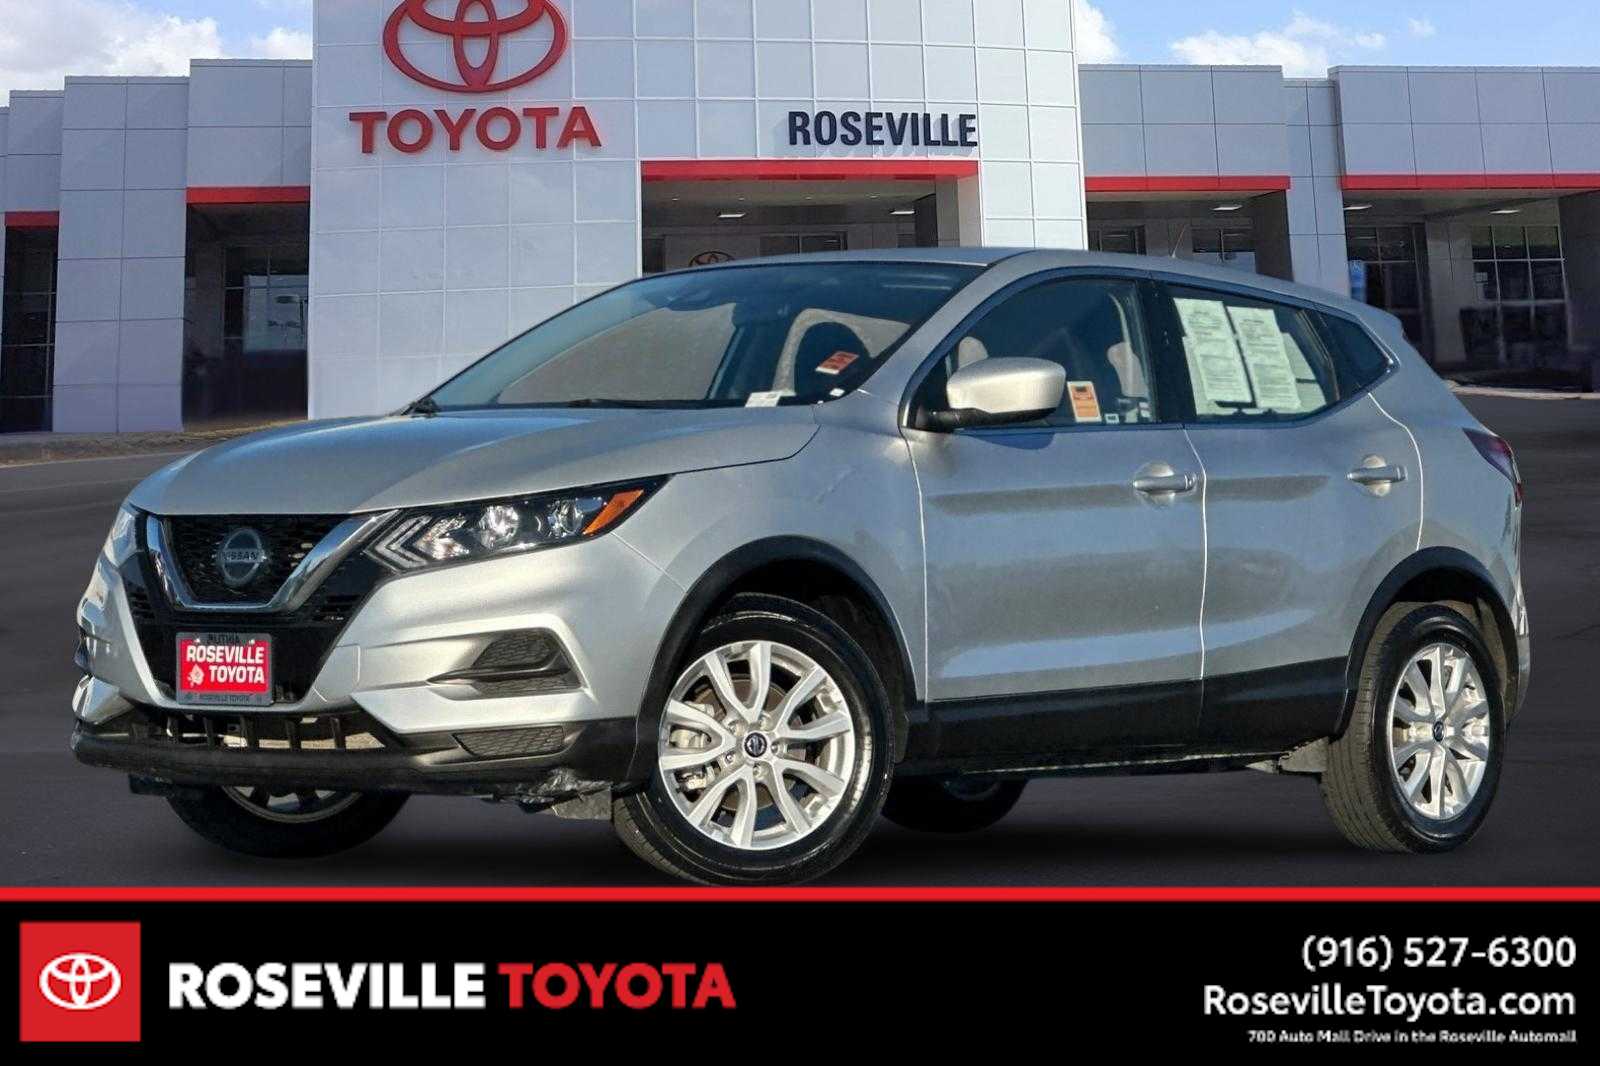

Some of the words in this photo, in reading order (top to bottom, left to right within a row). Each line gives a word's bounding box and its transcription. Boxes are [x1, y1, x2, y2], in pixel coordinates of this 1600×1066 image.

[349, 106, 601, 154] TOYOTA
[788, 111, 978, 147] ROSEVILLE
[186, 645, 265, 664] ROSEVILLE
[209, 665, 265, 684] TOYOTA
